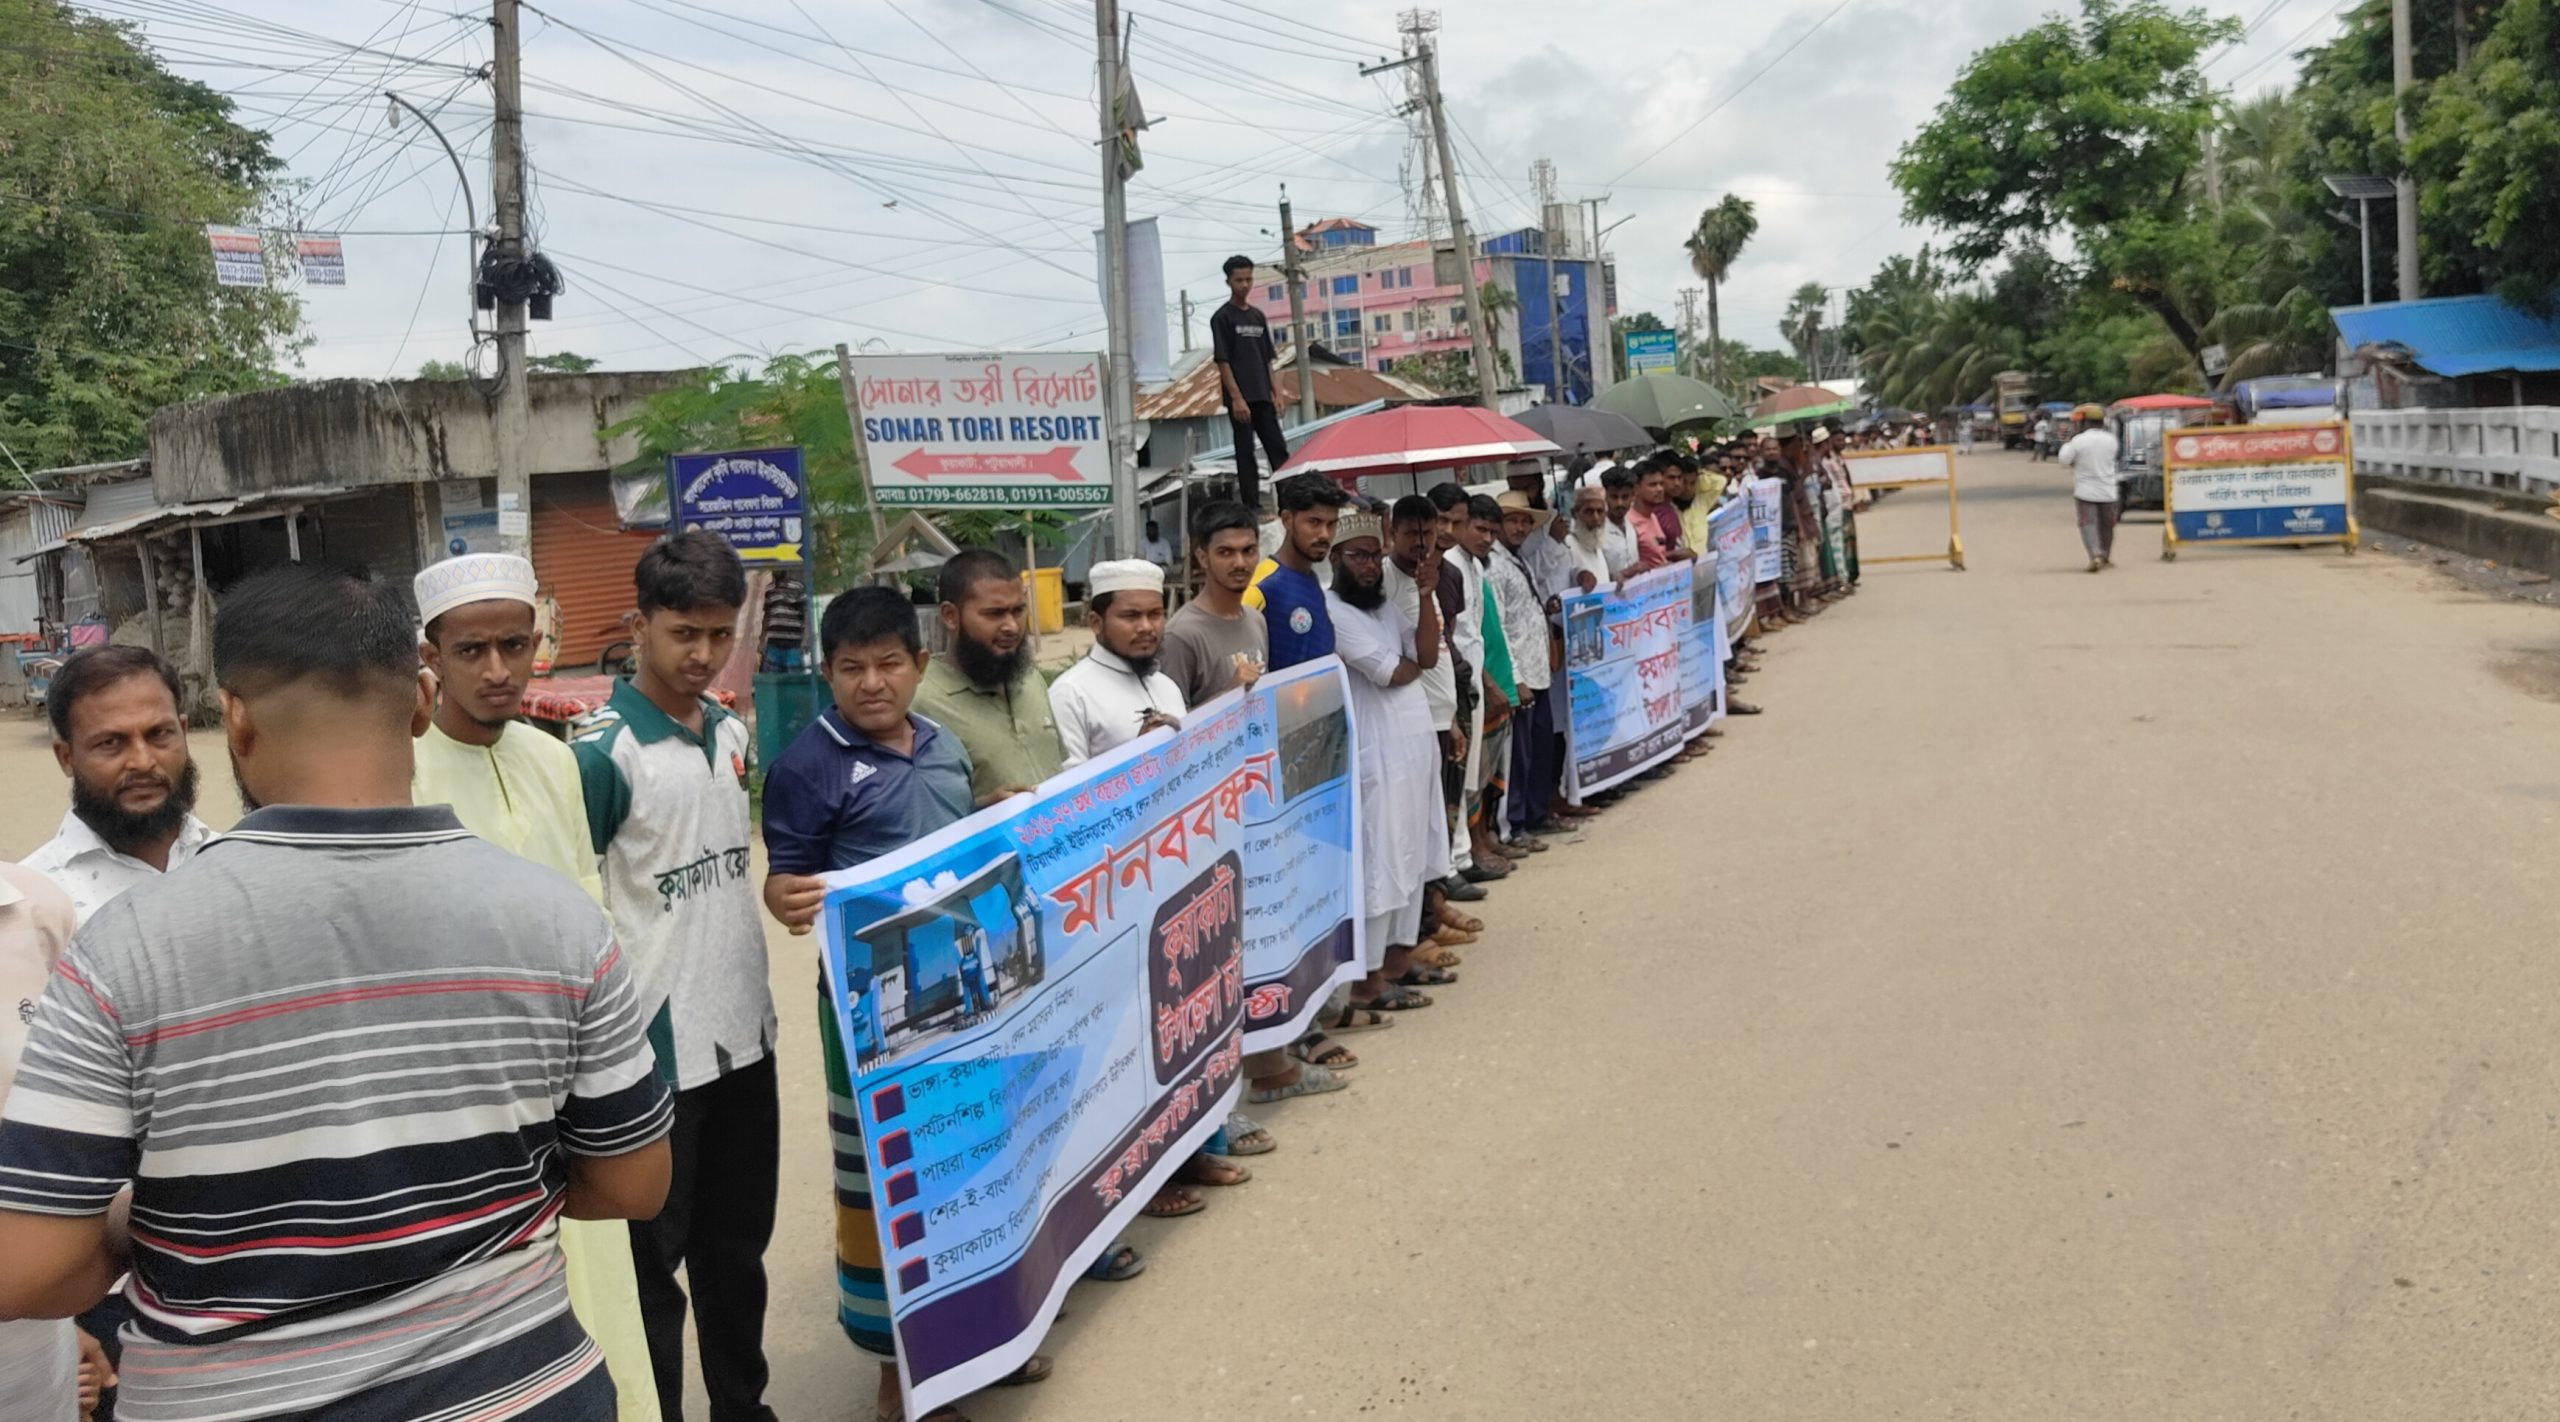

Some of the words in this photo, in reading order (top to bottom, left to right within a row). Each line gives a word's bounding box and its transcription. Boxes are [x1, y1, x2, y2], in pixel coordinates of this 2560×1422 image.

[861, 375, 942, 409] সোনার
[950, 363, 1004, 407] তরী
[1012, 362, 1098, 408] রিসোর্ট
[865, 416, 944, 442] SONAR
[948, 416, 1005, 441] TORI
[1011, 415, 1101, 441] RESORT
[2201, 436, 2240, 457] পুলিশ
[909, 488, 1009, 503] 01799-662818,
[1012, 487, 1109, 502] 01911-005567
[1051, 750, 1278, 938] মানববন্ধন
[654, 845, 719, 912] কুয়াকাটা
[1159, 862, 1236, 989] কুয়াকাটা
[1157, 965, 1223, 1065] উপজেলা
[914, 1100, 985, 1143] পর্যটনশিল্প
[1092, 1078, 1203, 1207] কুয়াকাটা
[922, 1151, 965, 1183] পায়রা
[932, 1223, 1006, 1274] কুয়াকাটায়
